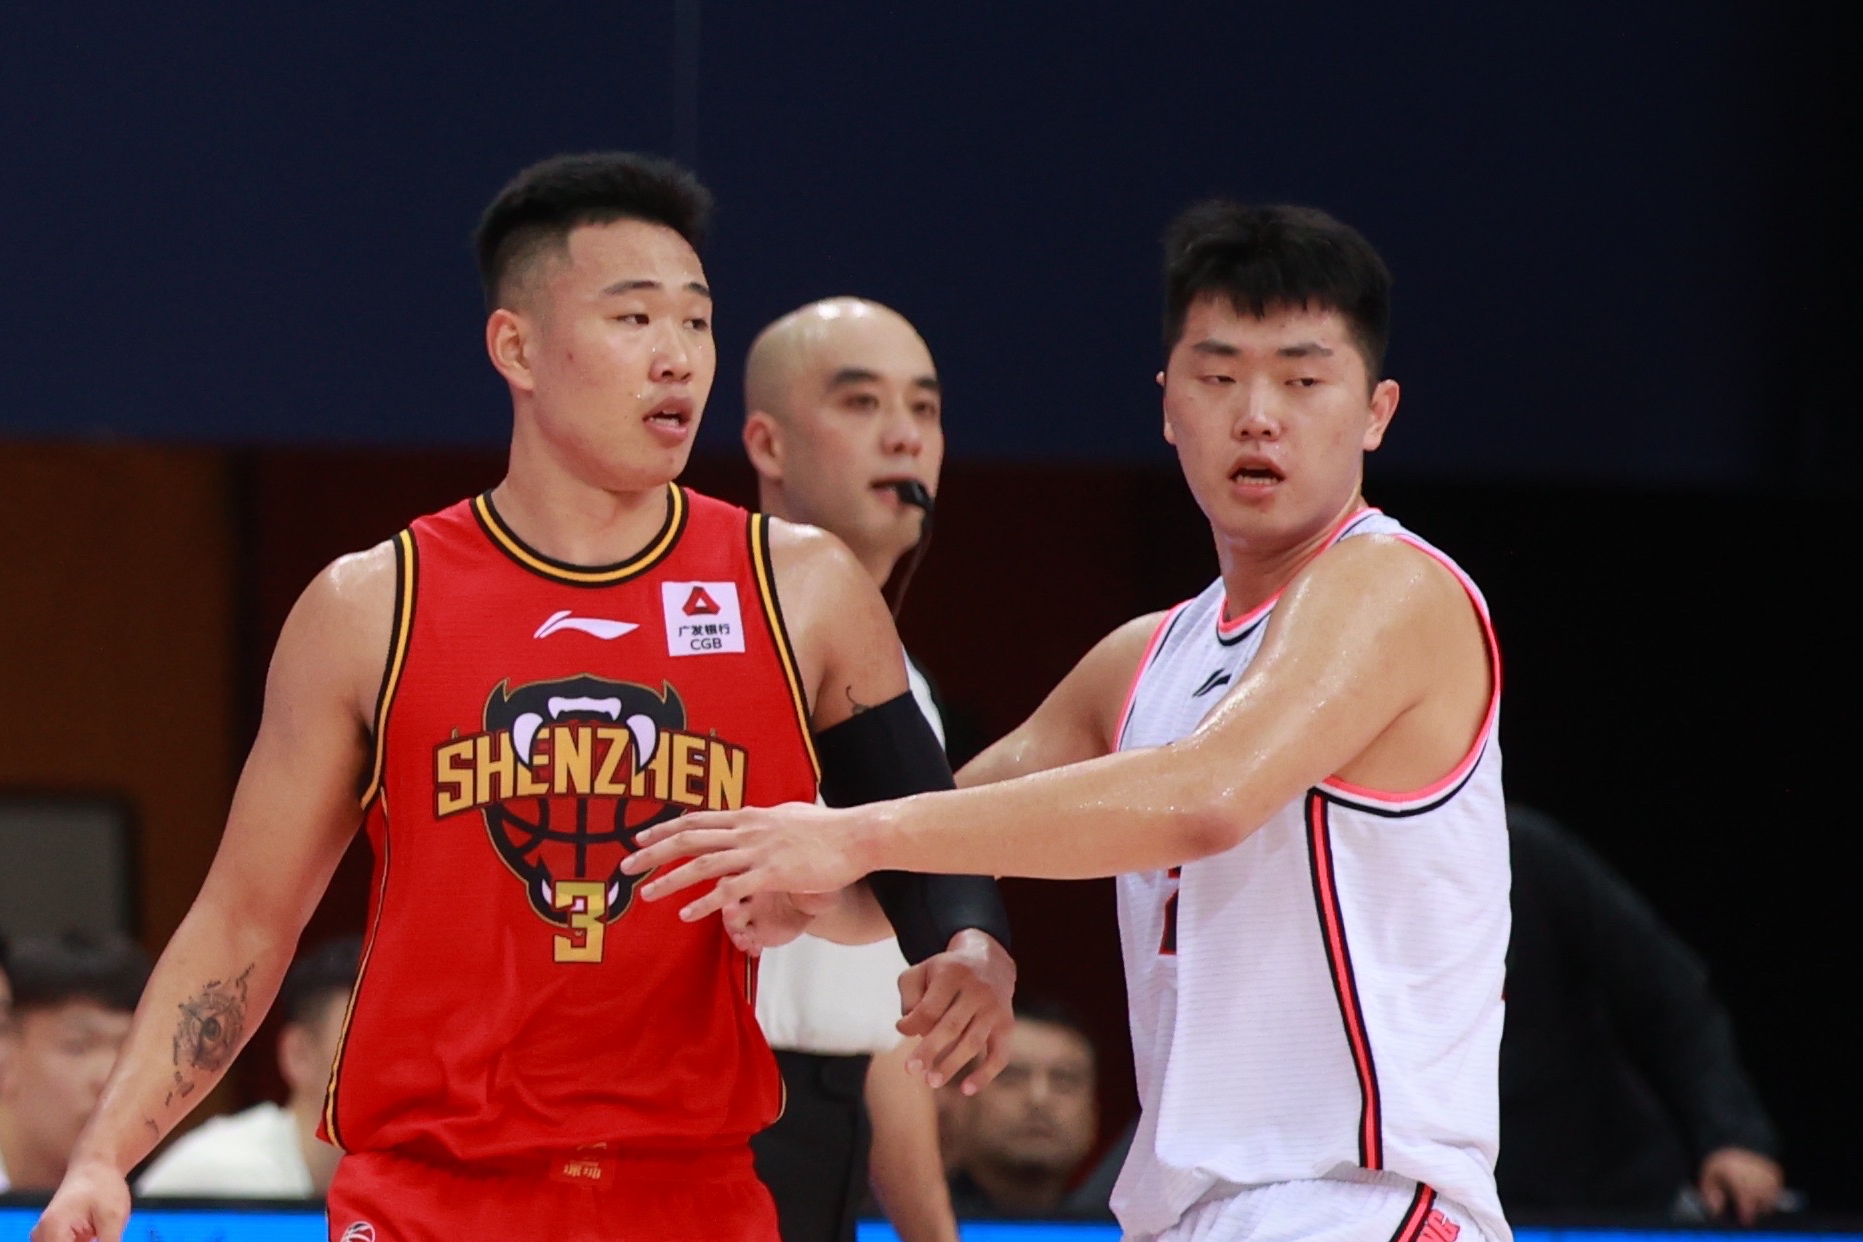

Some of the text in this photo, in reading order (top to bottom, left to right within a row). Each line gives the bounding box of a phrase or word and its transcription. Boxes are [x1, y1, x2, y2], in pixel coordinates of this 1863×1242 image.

[690, 637, 723, 651] CGB
[436, 725, 746, 818] SHENZHEN
[553, 879, 606, 963] 3
